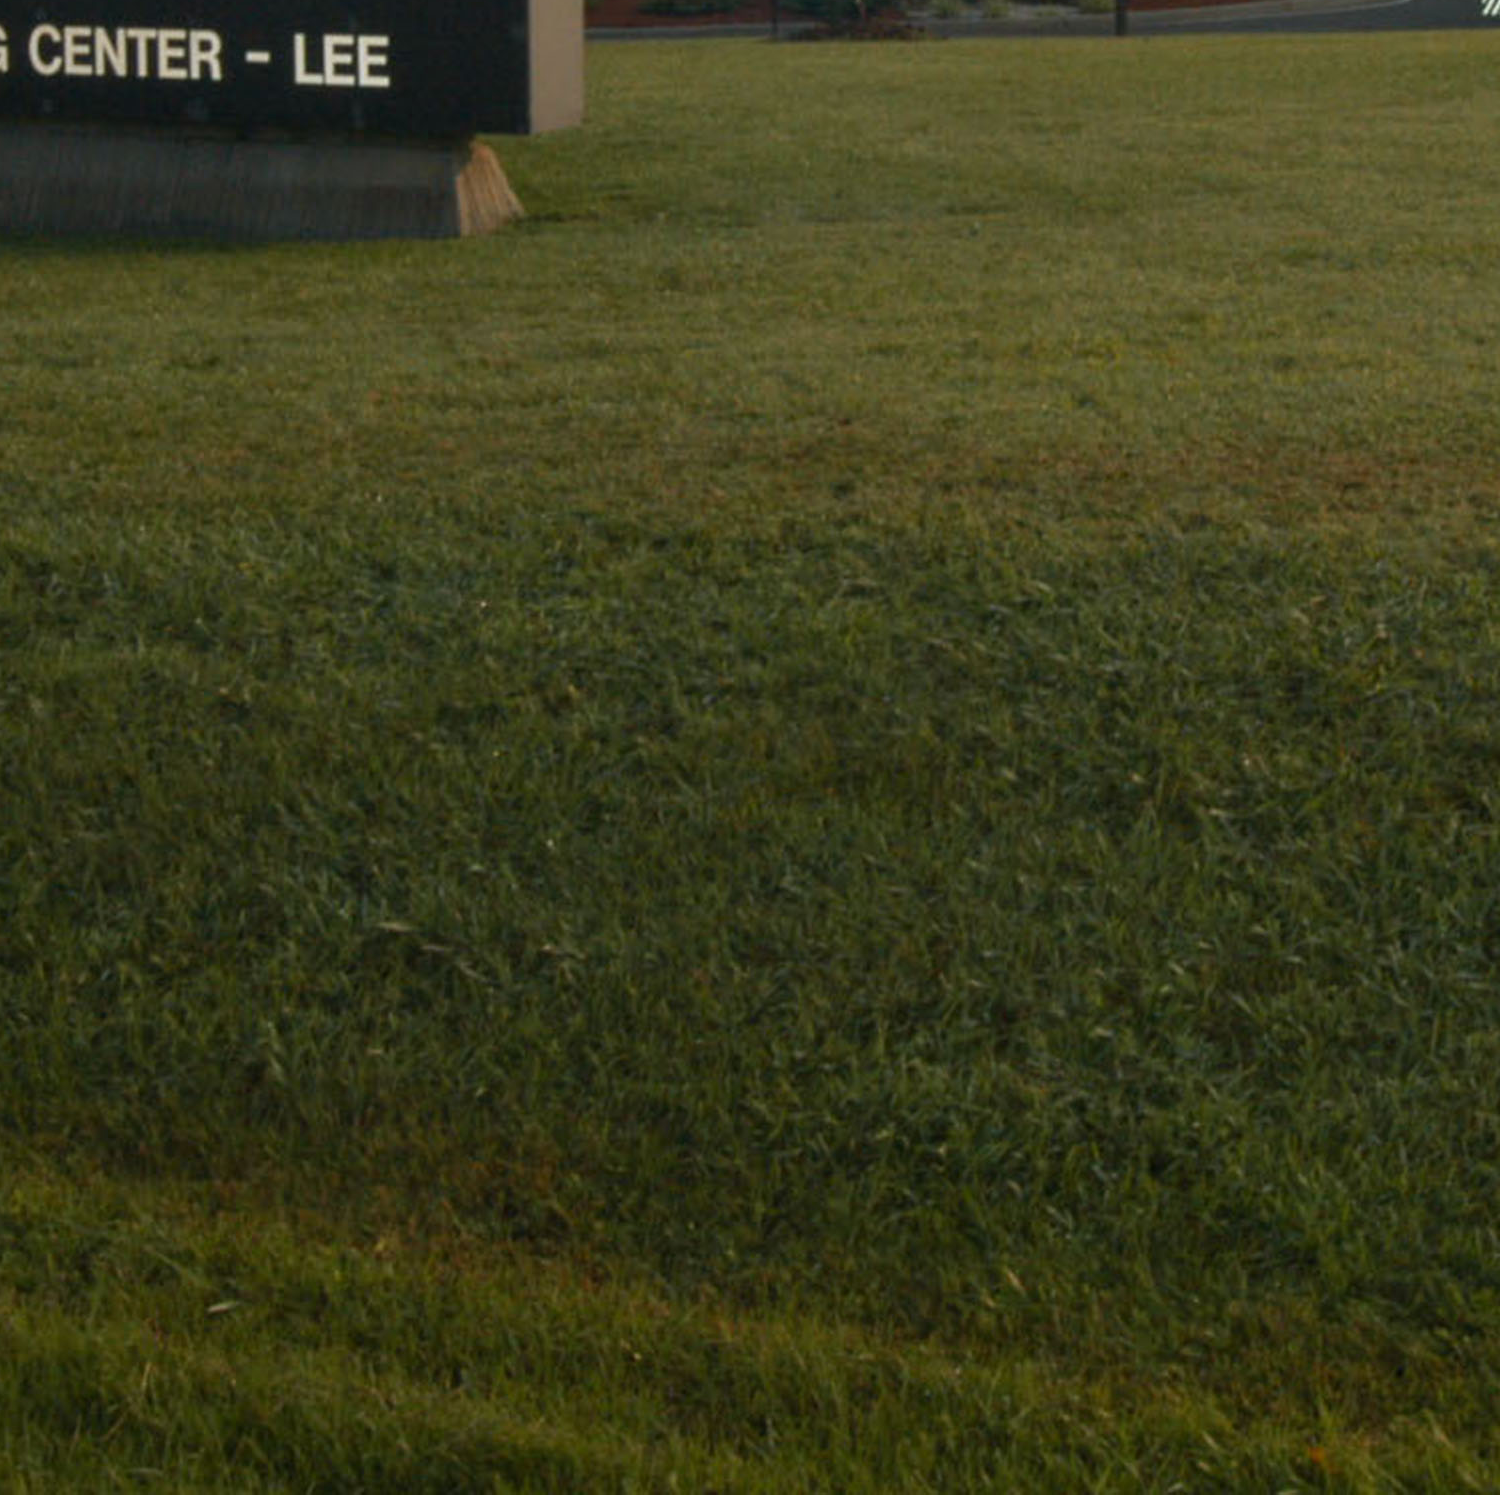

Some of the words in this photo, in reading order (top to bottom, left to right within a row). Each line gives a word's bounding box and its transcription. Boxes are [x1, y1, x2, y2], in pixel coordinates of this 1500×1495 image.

[29, 24, 222, 82] CENTER
[245, 51, 271, 63] -
[294, 32, 392, 88] LEE
